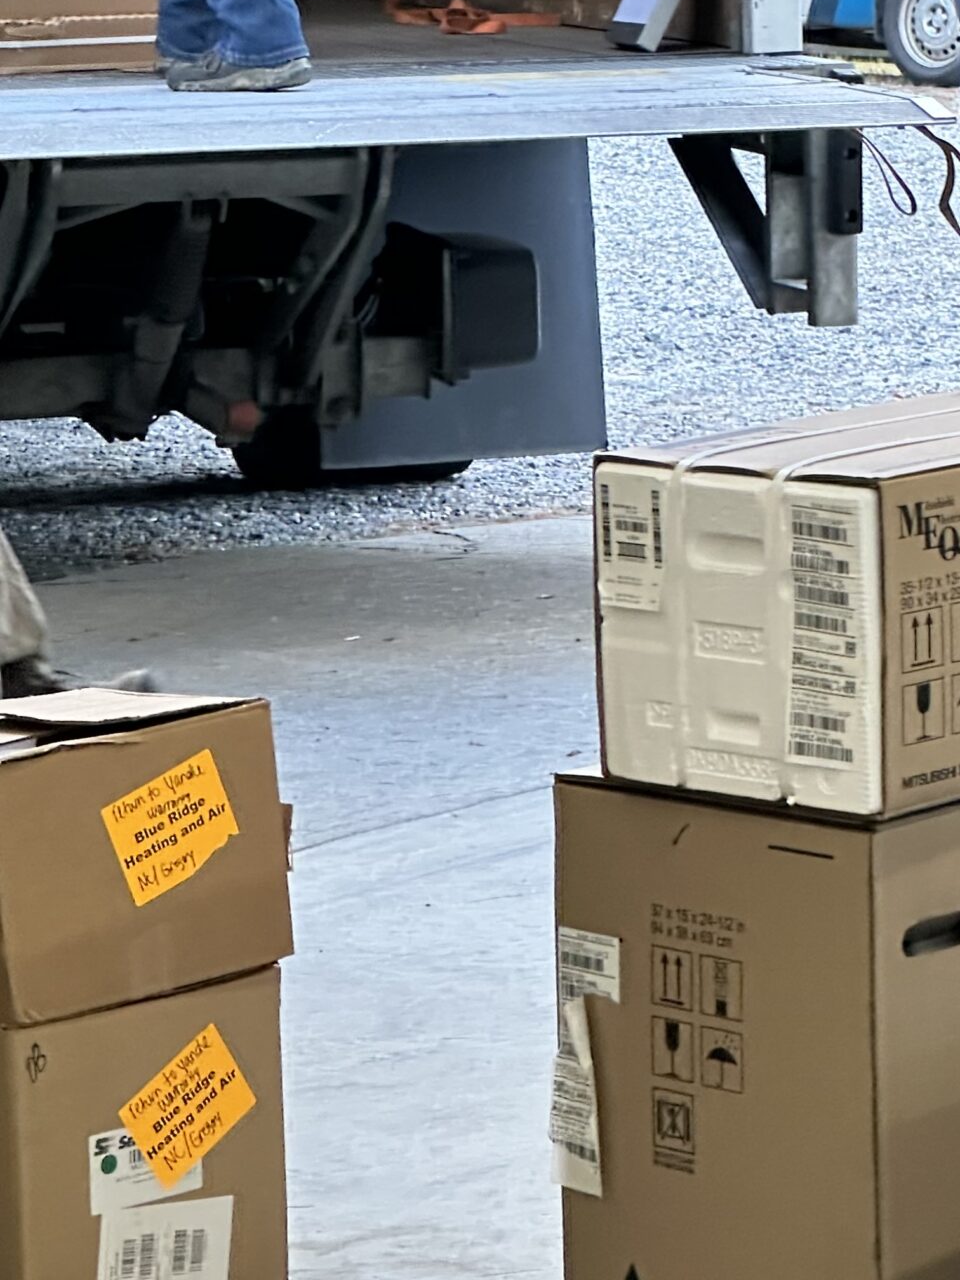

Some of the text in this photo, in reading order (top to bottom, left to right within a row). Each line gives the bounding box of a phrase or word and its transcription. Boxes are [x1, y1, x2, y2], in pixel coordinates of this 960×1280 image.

[902, 765, 957, 789] MITSUBISHI
[125, 804, 226, 870] Heating and Air
[134, 797, 206, 843] Blue Ridge
[147, 1069, 237, 1160] Heating and Air
[152, 1070, 216, 1133] Blue Ridge
